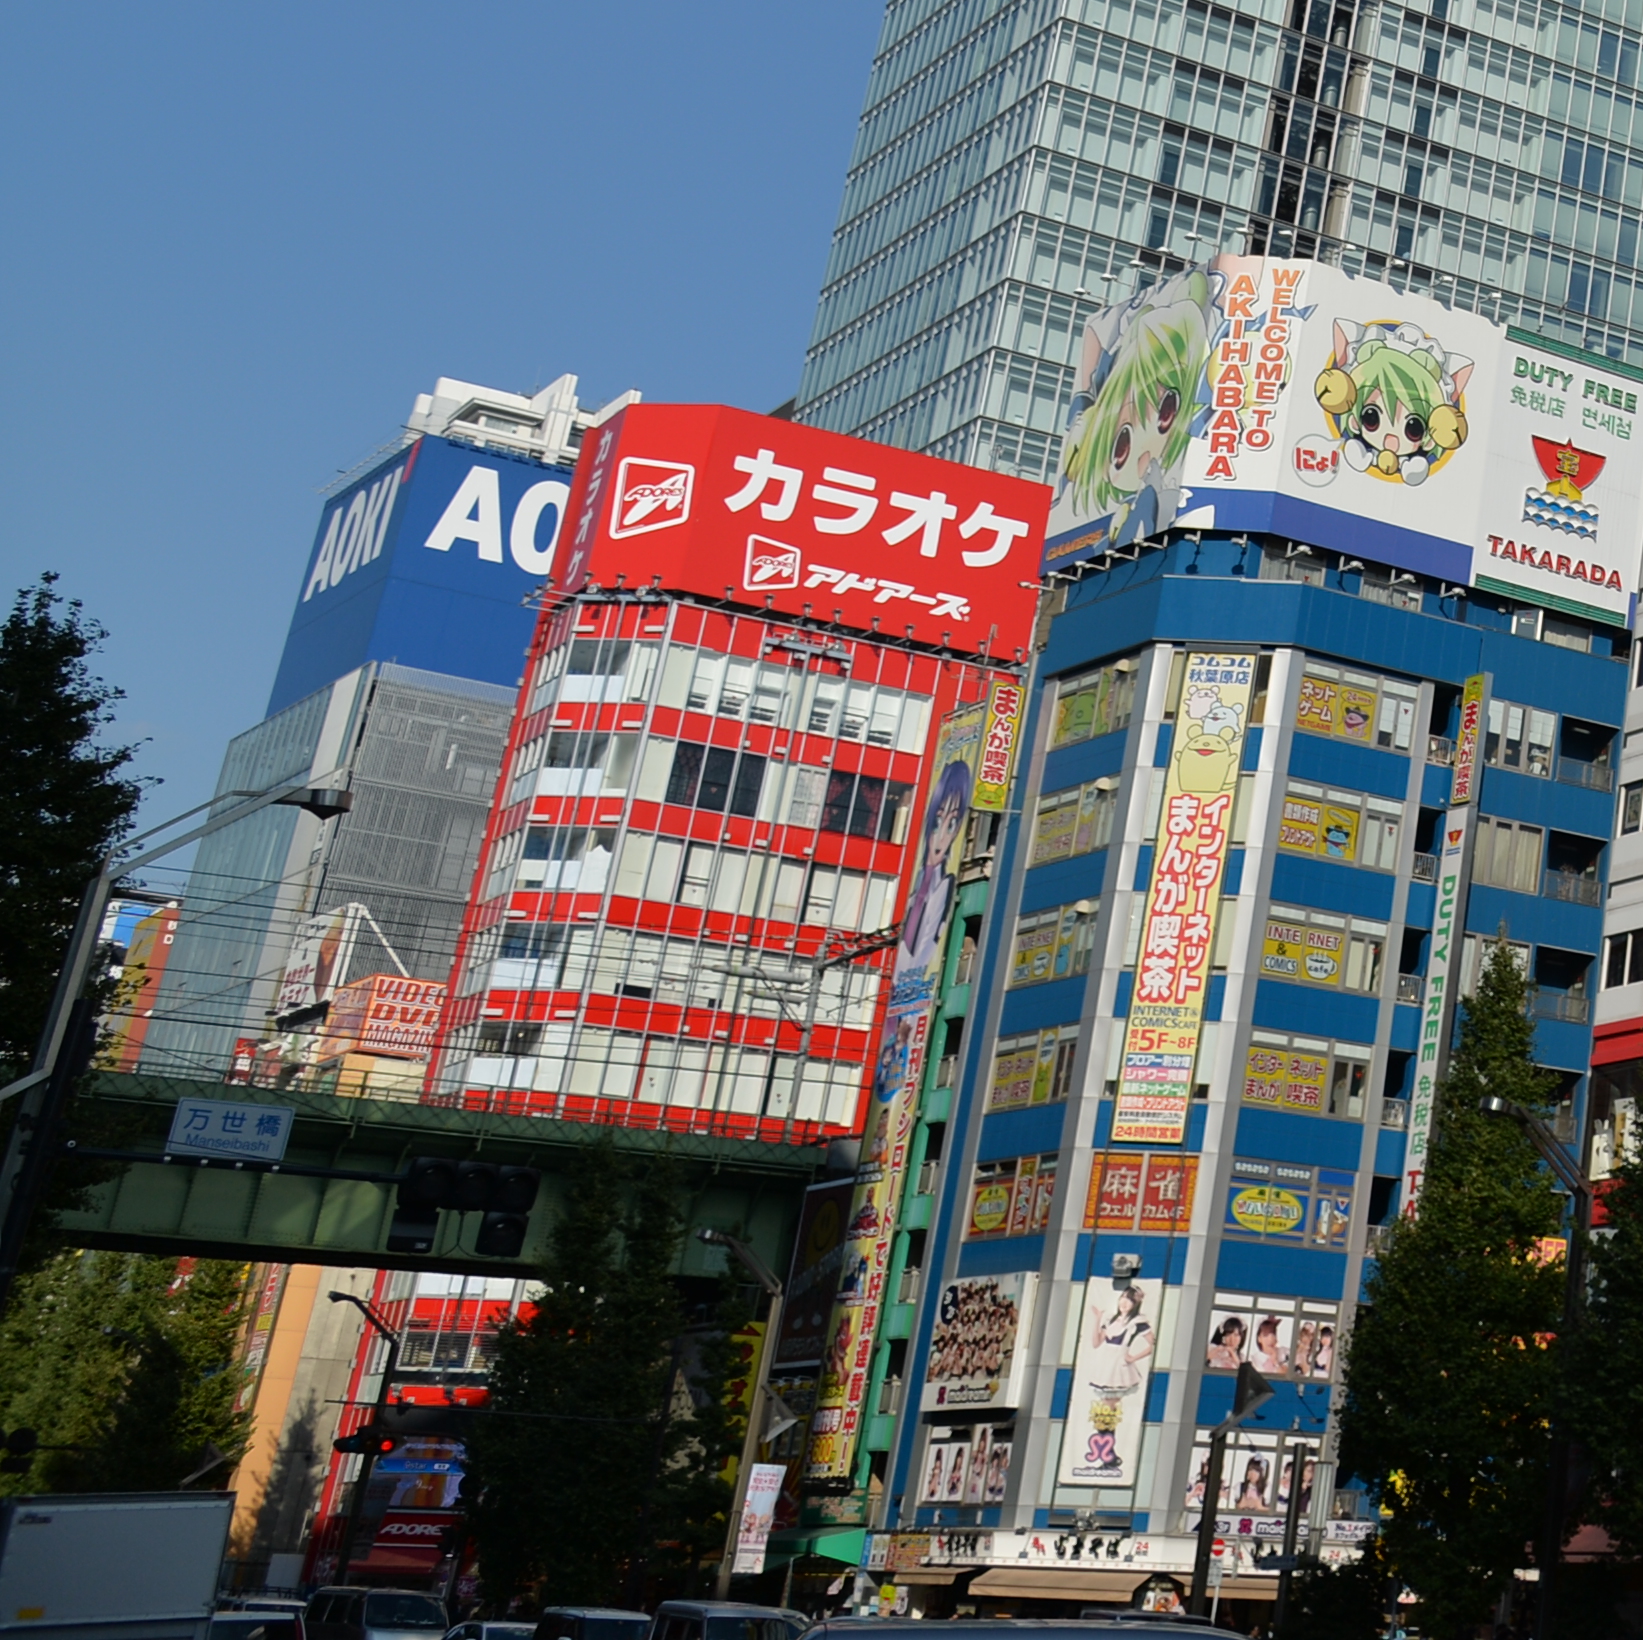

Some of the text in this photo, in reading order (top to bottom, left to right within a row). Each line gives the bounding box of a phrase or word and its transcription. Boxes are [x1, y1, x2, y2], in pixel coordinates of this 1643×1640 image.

[1205, 267, 1303, 481] WELCOME TO AKIHABARA
[1513, 355, 1639, 415] DUTY FREE
[1508, 384, 1565, 420] 免税店
[1581, 404, 1634, 441] 면세점
[423, 465, 572, 577] AO
[724, 446, 1031, 569] カラオケ
[302, 464, 405, 603] AOKI
[1487, 533, 1625, 593] TAKARADA
[805, 562, 971, 622] アドアーズ
[1188, 666, 1250, 686] 秋葉原店
[1301, 680, 1336, 703] ネット
[1299, 701, 1332, 723] ゲーム
[980, 685, 1019, 785] まんが喫茶
[1137, 794, 1202, 1005] まんが喫茶
[1176, 795, 1230, 1005] インターネット
[1436, 874, 1457, 966] DUTY
[1263, 955, 1298, 975] COMICS
[1276, 942, 1288, 956] &
[1131, 1016, 1179, 1028] COMICS
[1132, 1005, 1190, 1017] INTERNET
[1420, 974, 1446, 1065] FREE
[182, 1107, 283, 1138] 万世橋
[1113, 1125, 1182, 1140] 24時間営業
[184, 1131, 272, 1154] Manseibashi
[1101, 1166, 1186, 1202] 麻雀
[1134, 1541, 1150, 1552] 24
